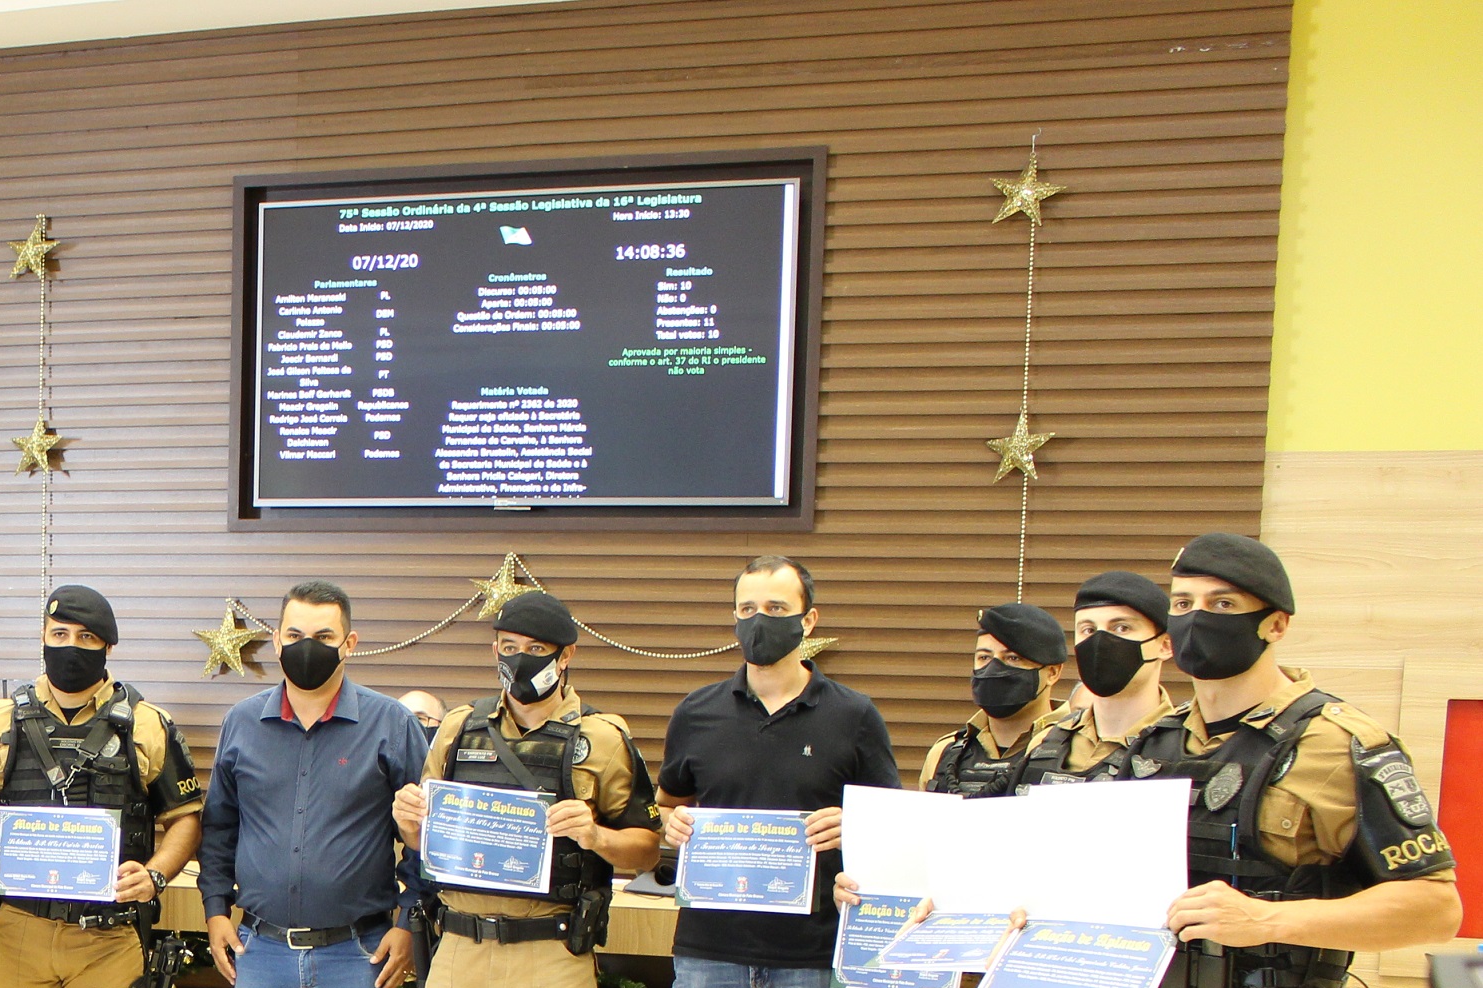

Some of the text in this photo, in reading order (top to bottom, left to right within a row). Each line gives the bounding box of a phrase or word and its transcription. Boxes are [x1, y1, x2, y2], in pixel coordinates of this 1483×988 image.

[360, 206, 400, 217] Sessão
[401, 203, 454, 215] Ordinária
[455, 202, 471, 213] da
[488, 200, 529, 211] Sessão
[531, 198, 593, 211] Legislativa
[594, 196, 610, 207] da
[636, 193, 702, 206] Legislatura
[612, 208, 690, 220] Hora Início: 13:30
[338, 219, 434, 232] Data Início: 07/12/2020
[615, 243, 686, 259] 14:08:36
[351, 253, 418, 270] 07/12/20
[487, 272, 547, 282] Cronômetros
[665, 266, 713, 276] Resultado
[313, 279, 377, 288] Parlamentares
[656, 280, 692, 291] Sim: 10
[477, 284, 557, 296] Discurso: 00:05:00
[480, 297, 553, 309] Aparte: 00:05:00
[656, 292, 686, 303] Não: 0
[655, 304, 717, 316] Abstenções: 0
[655, 317, 715, 327] Presentes: 11
[654, 328, 719, 339] Total votos: 10
[621, 345, 747, 359] Aprovada por maioria simples
[607, 357, 648, 366] conforme
[656, 357, 672, 365] art.
[674, 356, 687, 366] 37
[687, 356, 700, 366] do
[700, 355, 711, 364] RI
[720, 355, 766, 365] presidente
[667, 365, 704, 374] não vota
[442, 793, 475, 809] Moção
[477, 798, 488, 810] de
[491, 800, 536, 817] Aplauso
[12, 819, 103, 834] Moção de Aplauso
[700, 822, 798, 836] Moção de Aplauso
[1380, 831, 1451, 870] ROCA
[858, 903, 893, 918] Moção
[894, 906, 906, 917] de
[1029, 928, 1152, 952] Moção de Aplauso
